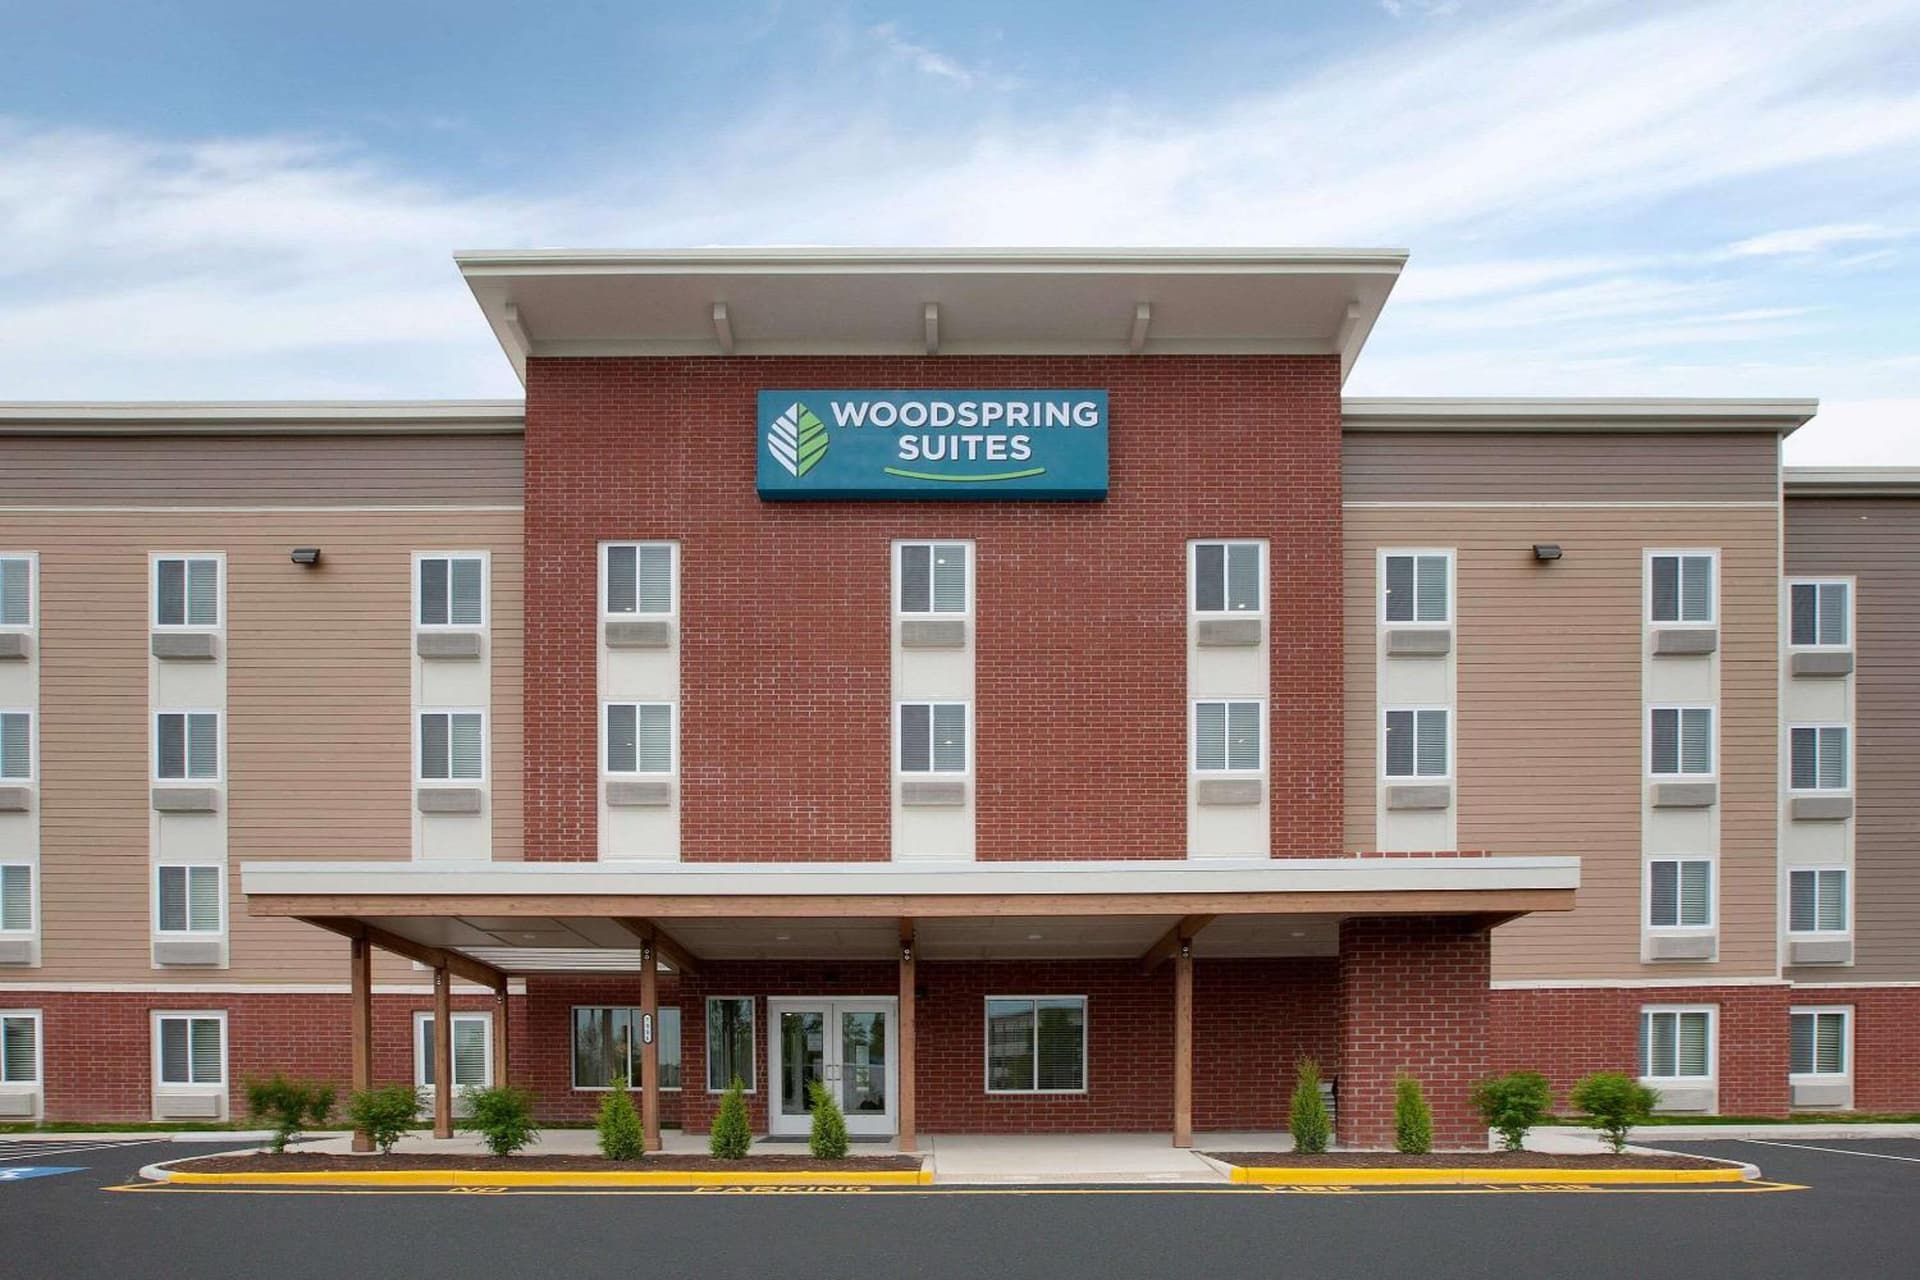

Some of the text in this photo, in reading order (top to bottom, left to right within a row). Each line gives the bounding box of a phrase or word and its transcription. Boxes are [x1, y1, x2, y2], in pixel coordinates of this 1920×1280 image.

[830, 401, 1099, 428] WOODSPRING
[898, 434, 1032, 461] SUITES
[693, 1185, 872, 1193] PARKING
